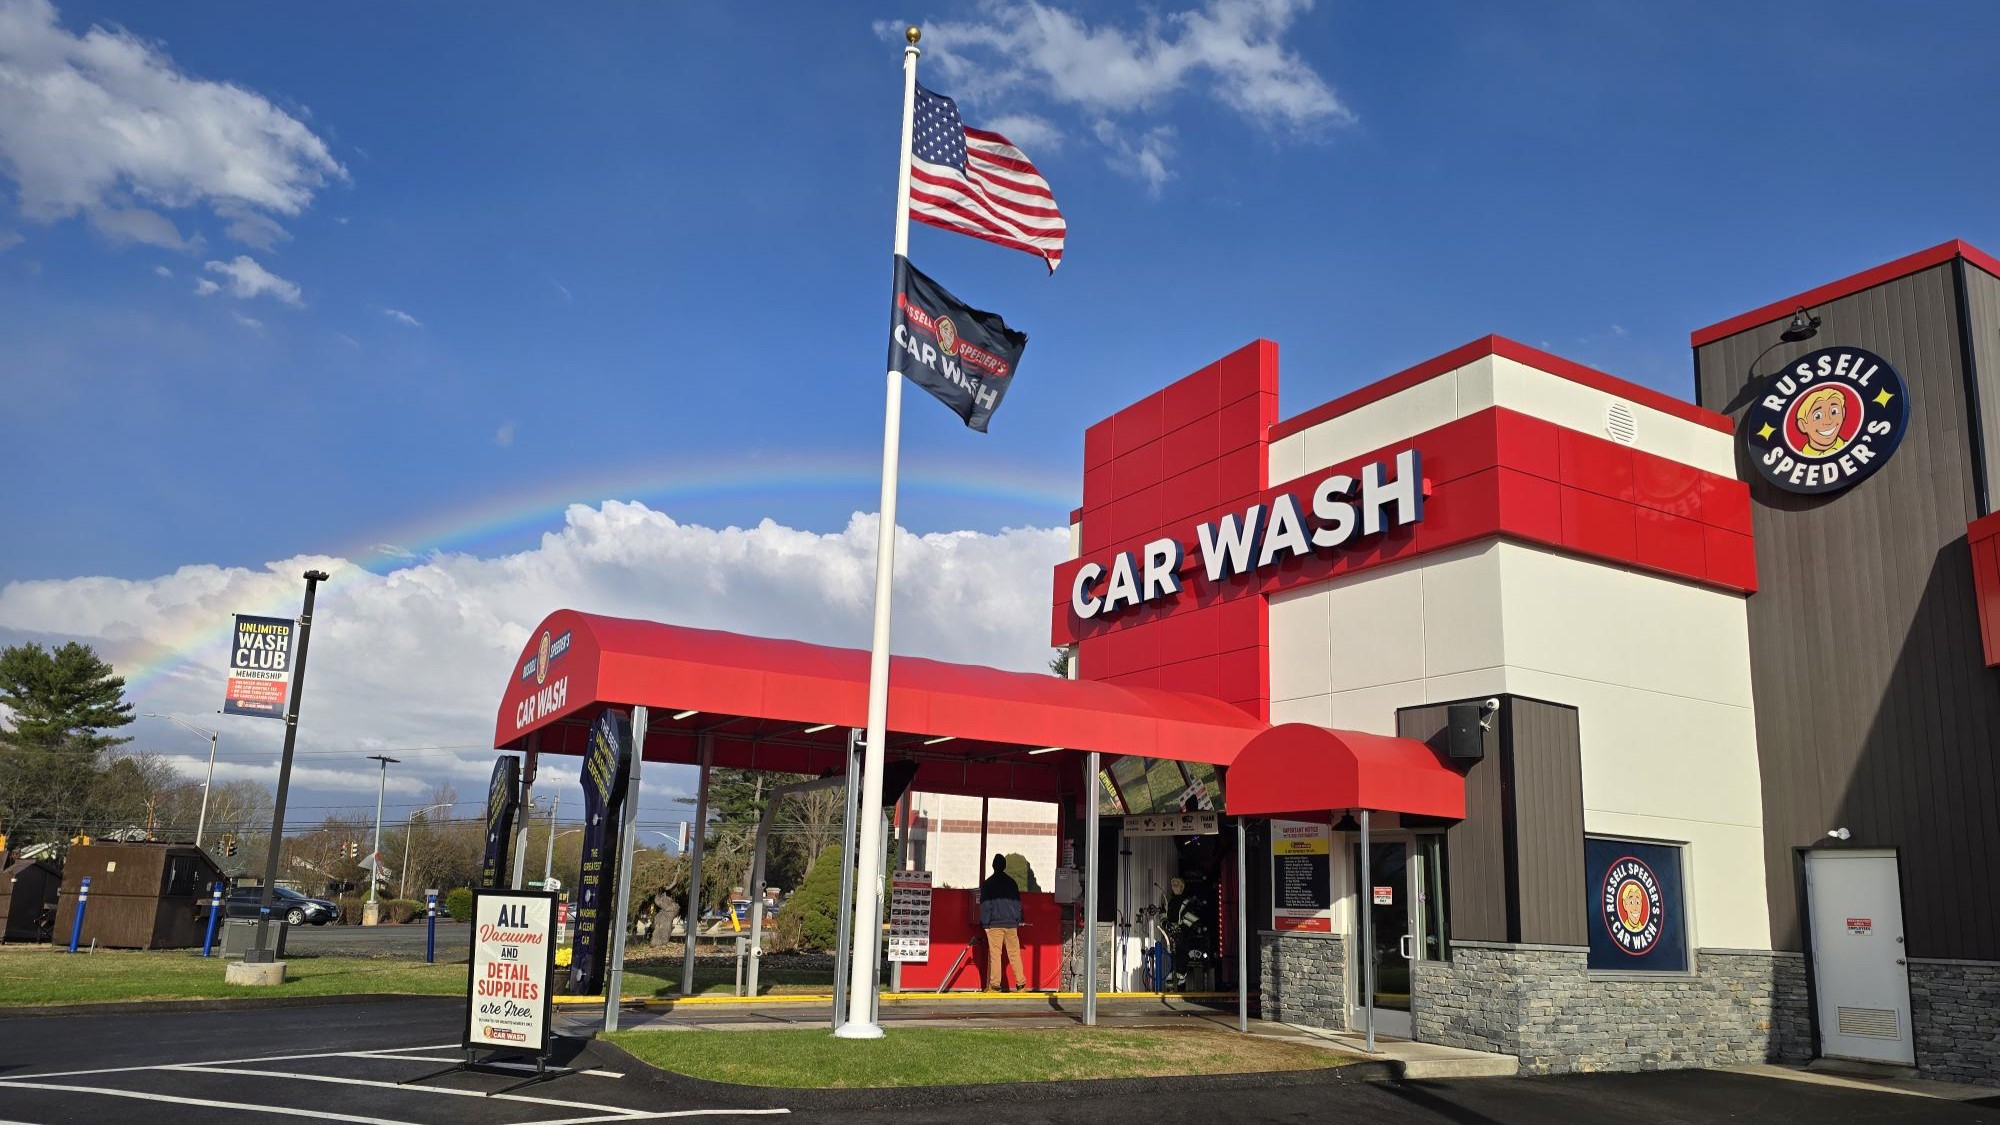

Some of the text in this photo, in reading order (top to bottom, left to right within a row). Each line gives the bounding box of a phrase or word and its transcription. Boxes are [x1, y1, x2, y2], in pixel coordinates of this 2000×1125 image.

[895, 324, 998, 410] CAR WASH
[1762, 354, 1884, 412] RUSSELL
[1763, 420, 1891, 486] SPEEDER'S
[1071, 449, 1416, 619] CAR WASH
[240, 623, 289, 636] UNLIMITED
[239, 632, 288, 651] WASH
[236, 648, 286, 670] CLUB
[236, 670, 281, 680] MEMBERSHIP
[516, 676, 568, 729] CAR WASH
[1606, 863, 1660, 915] RUSSELL SPEEDER'S
[497, 904, 528, 928] ALL
[480, 923, 543, 944] Vacuums
[1612, 921, 1657, 949] CAR WASH
[500, 947, 518, 958] AND
[487, 962, 530, 980] DETAIL
[478, 980, 538, 1000] SUPPLIES
[480, 1000, 533, 1018] are Free.
